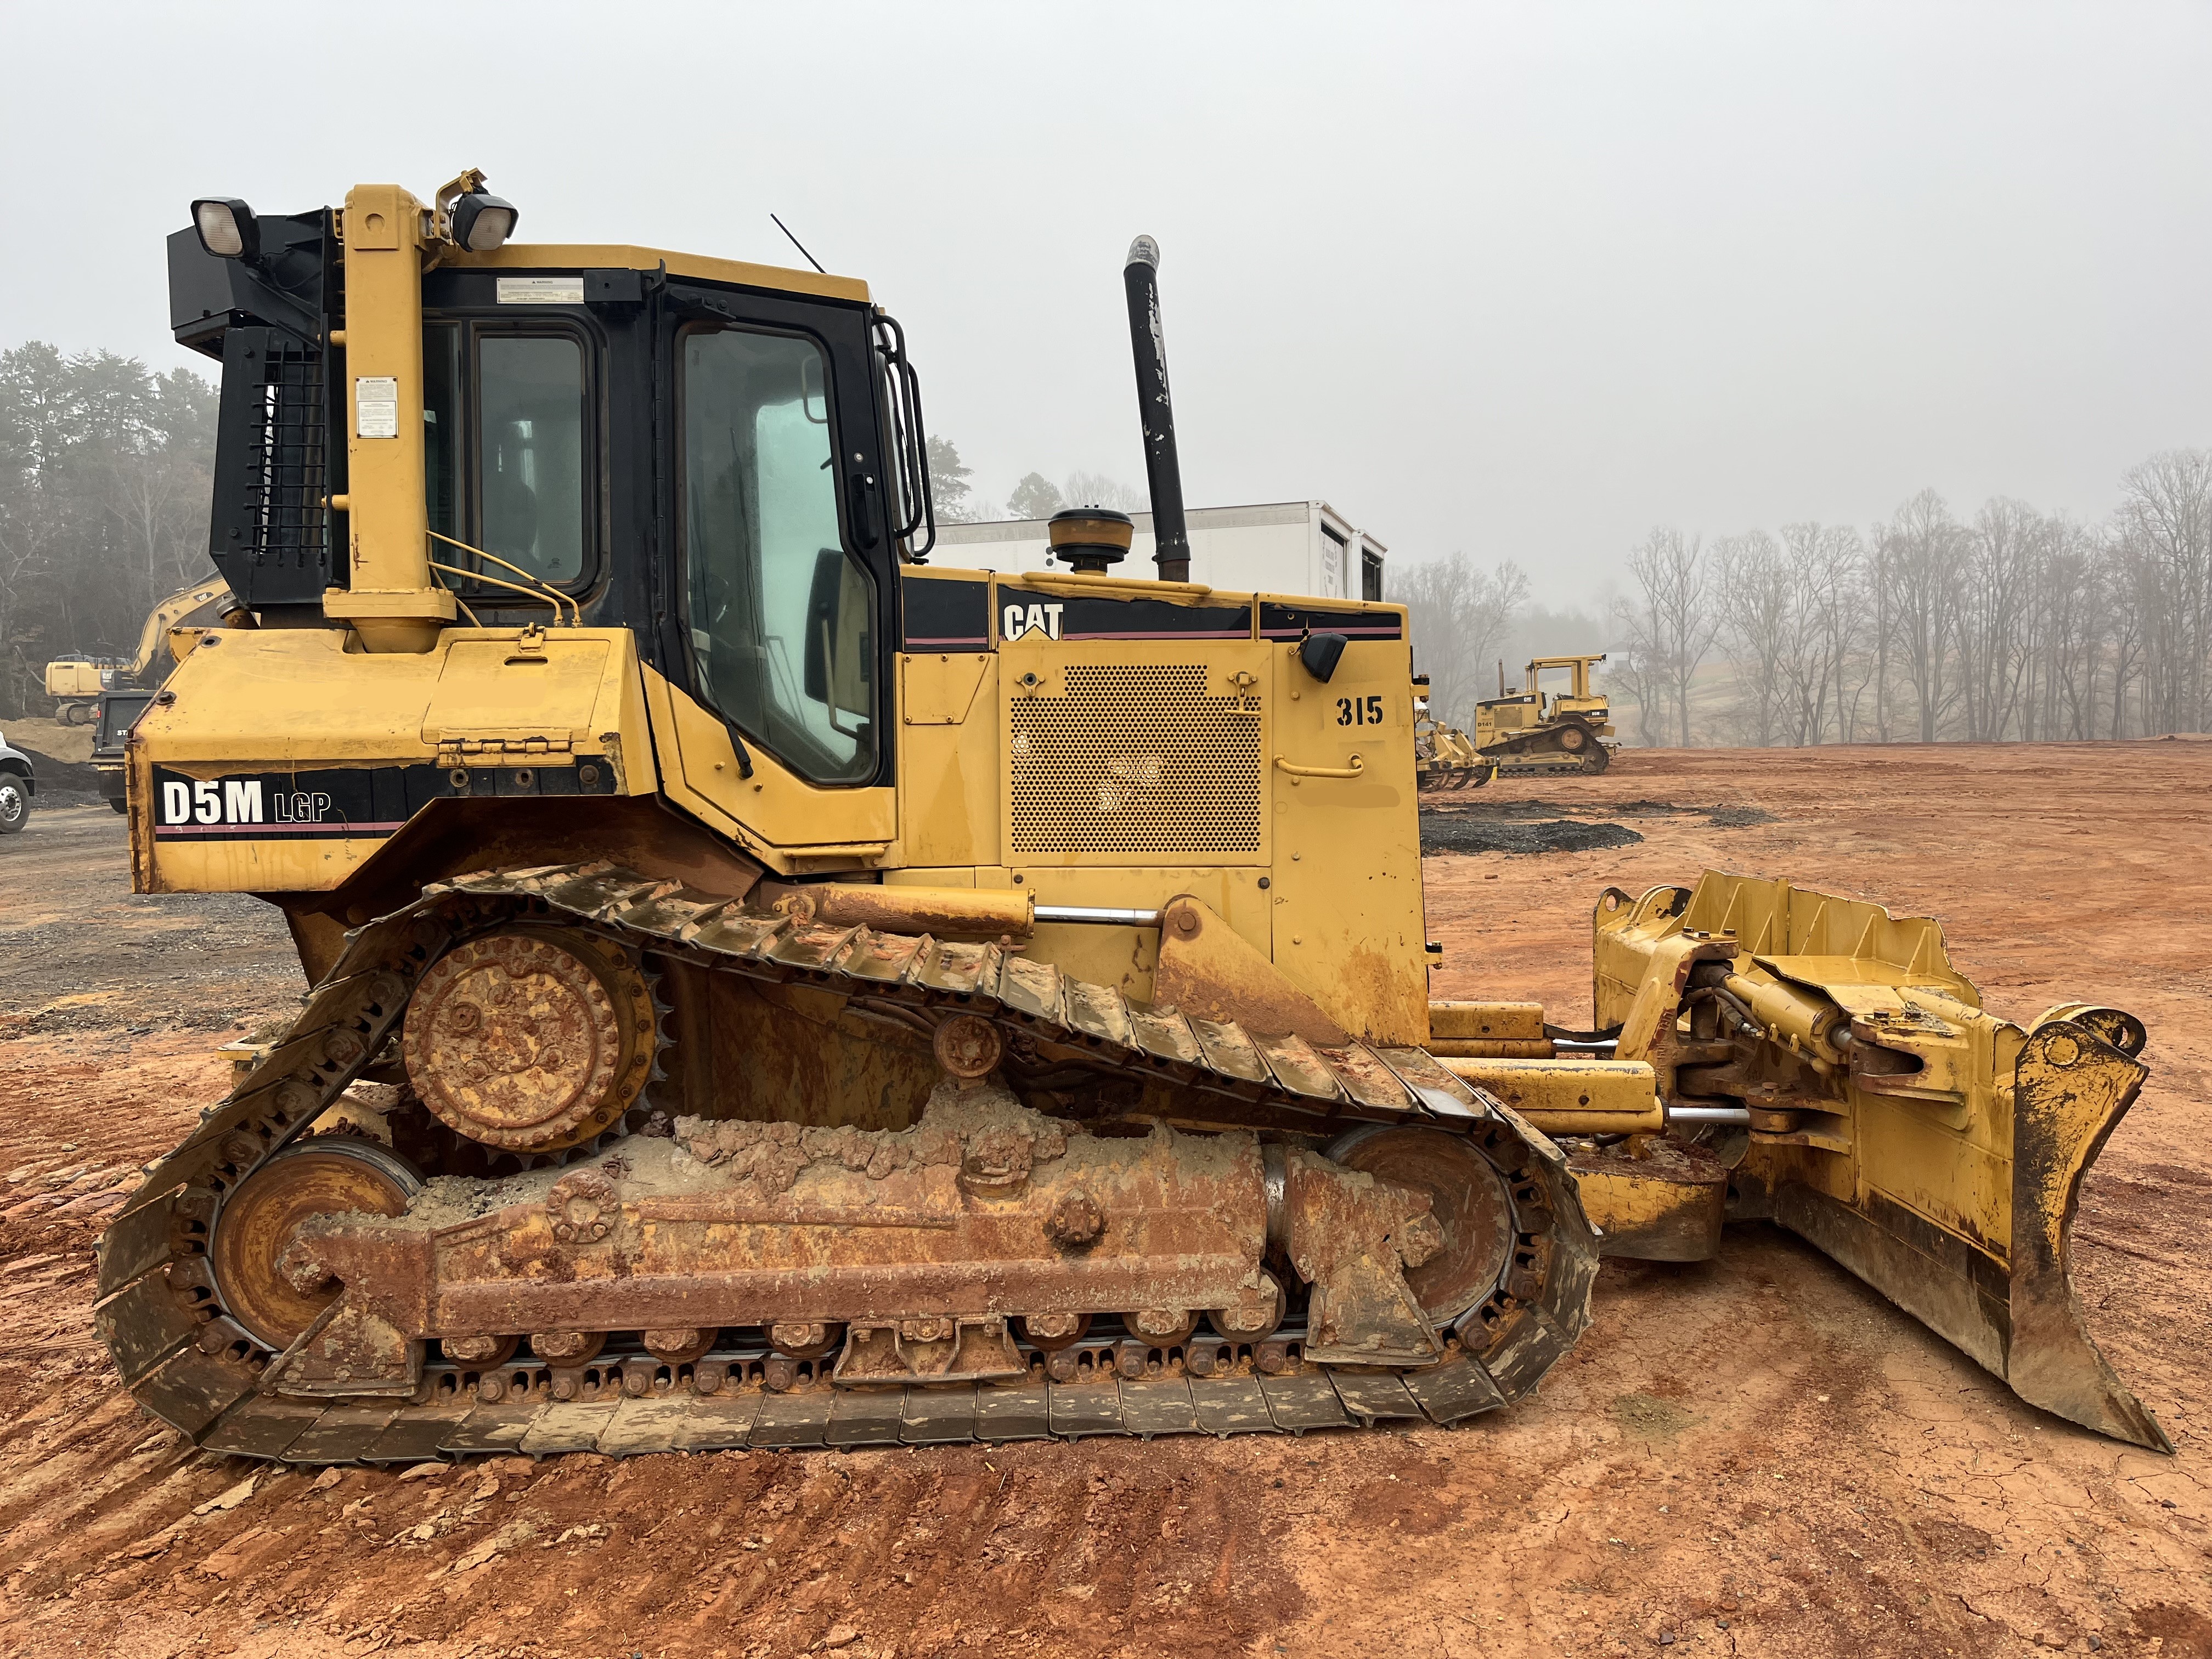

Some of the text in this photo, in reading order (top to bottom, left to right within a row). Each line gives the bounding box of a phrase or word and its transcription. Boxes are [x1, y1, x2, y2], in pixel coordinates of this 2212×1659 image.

[1004, 603, 1063, 641] CAT
[1336, 696, 1383, 726] 315
[163, 781, 330, 824] D5M LGP
